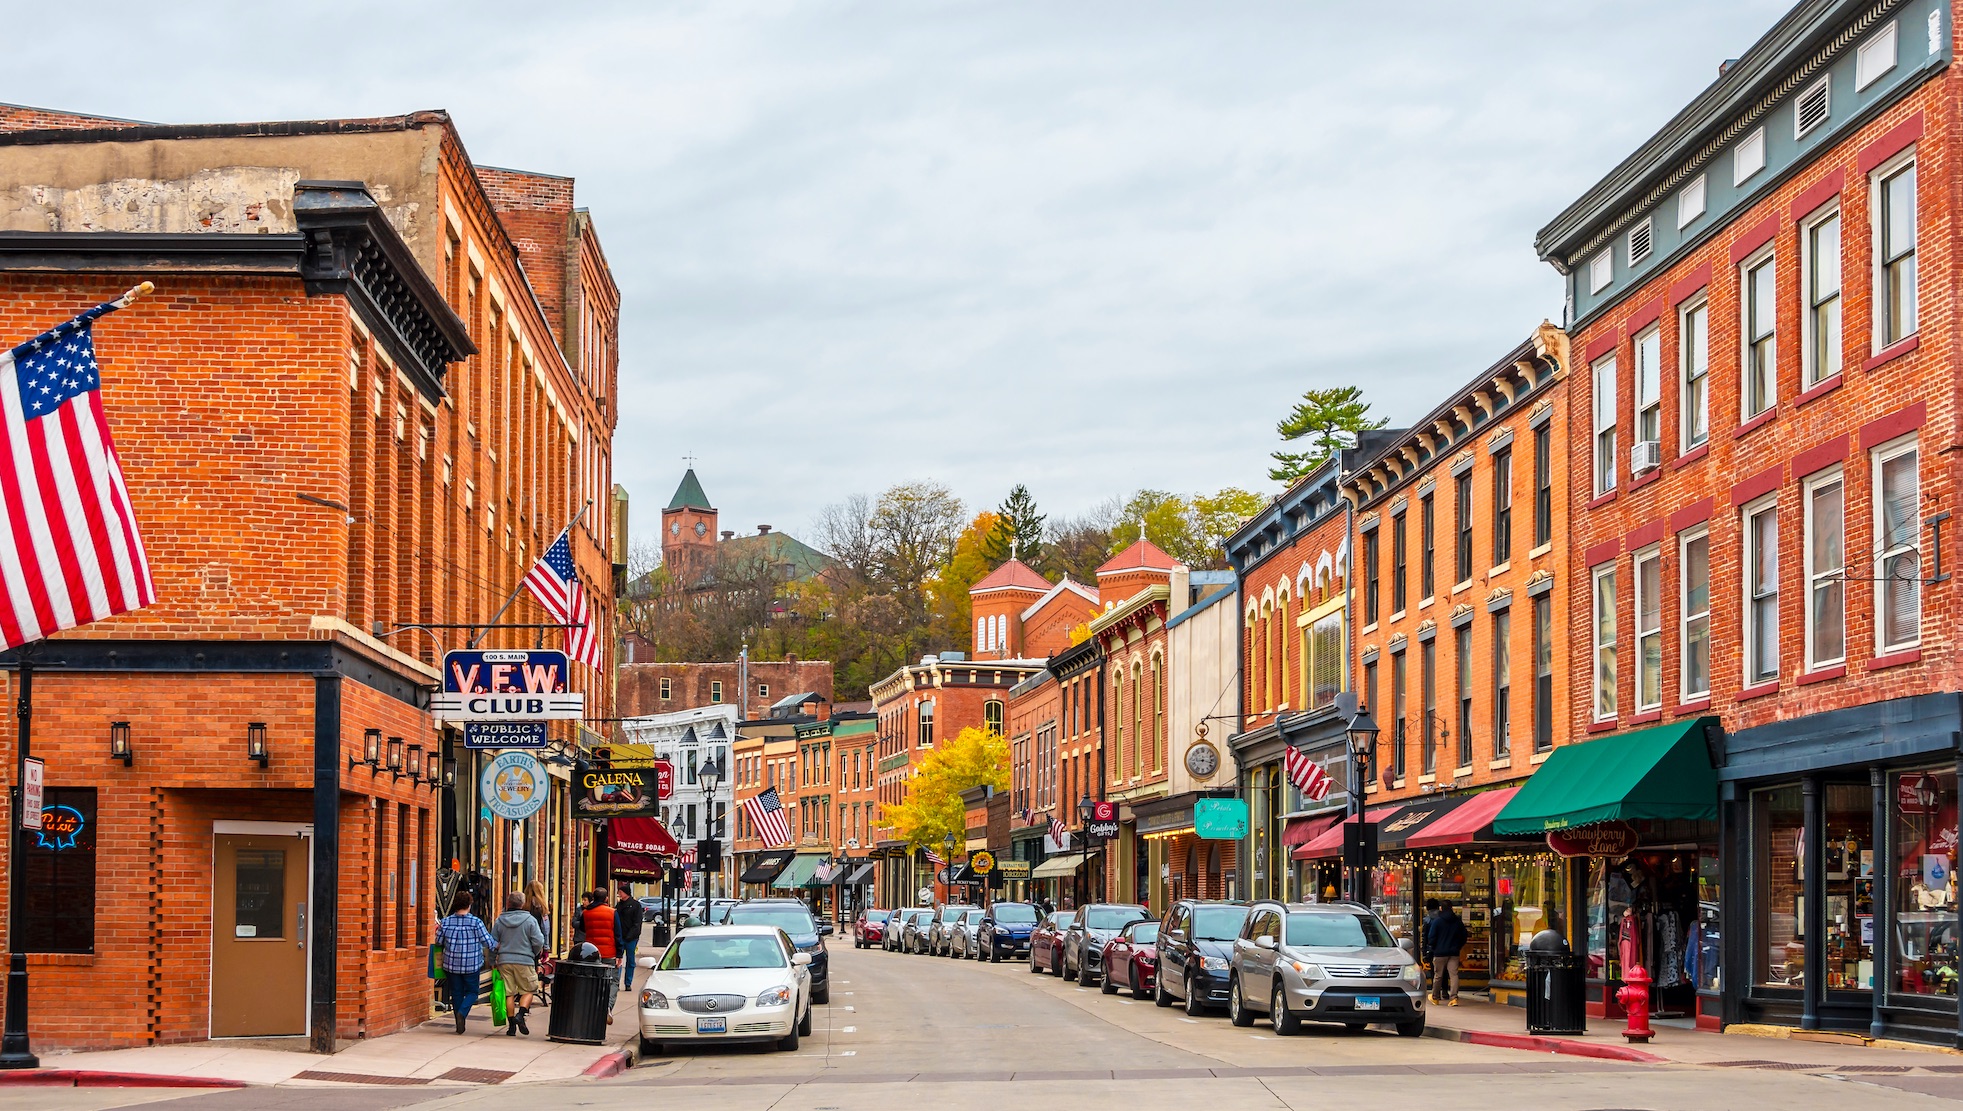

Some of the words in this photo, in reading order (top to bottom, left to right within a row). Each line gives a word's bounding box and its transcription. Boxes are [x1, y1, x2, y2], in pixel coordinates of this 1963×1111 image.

[452, 663, 564, 694] V.F.W.
[468, 698, 544, 714] CLUB
[481, 724, 531, 734] PUBLIC
[472, 735, 540, 744] WELCOME
[496, 755, 536, 769] EARTH'S
[583, 772, 645, 789] GALENA
[27, 783, 41, 797] PARKING
[489, 795, 541, 817] TREASURES
[1562, 825, 1626, 848] Strawberry
[617, 840, 644, 850] VINTAGE
[645, 843, 666, 852] SODAS
[1587, 839, 1619, 854] Lane
